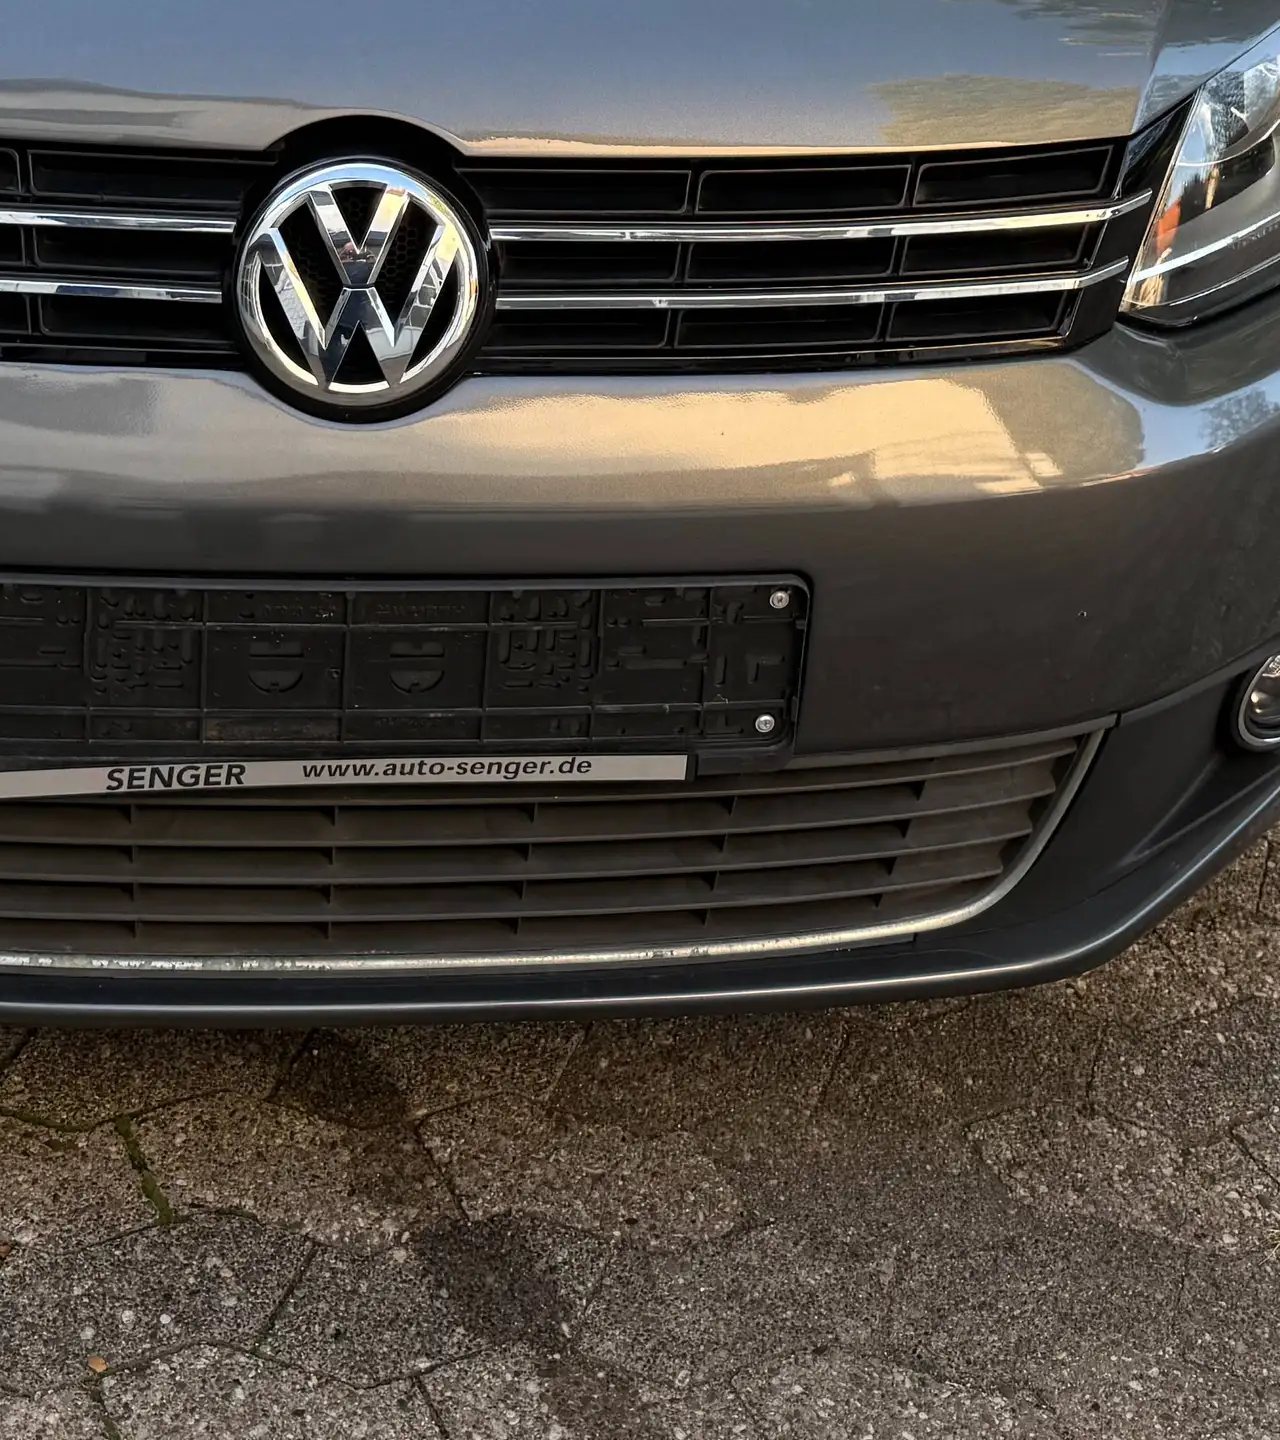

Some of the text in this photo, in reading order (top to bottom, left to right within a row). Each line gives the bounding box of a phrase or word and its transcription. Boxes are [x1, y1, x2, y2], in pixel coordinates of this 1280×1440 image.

[238, 164, 478, 405] VW
[106, 757, 592, 791] SENGER www.auto-senger.de
